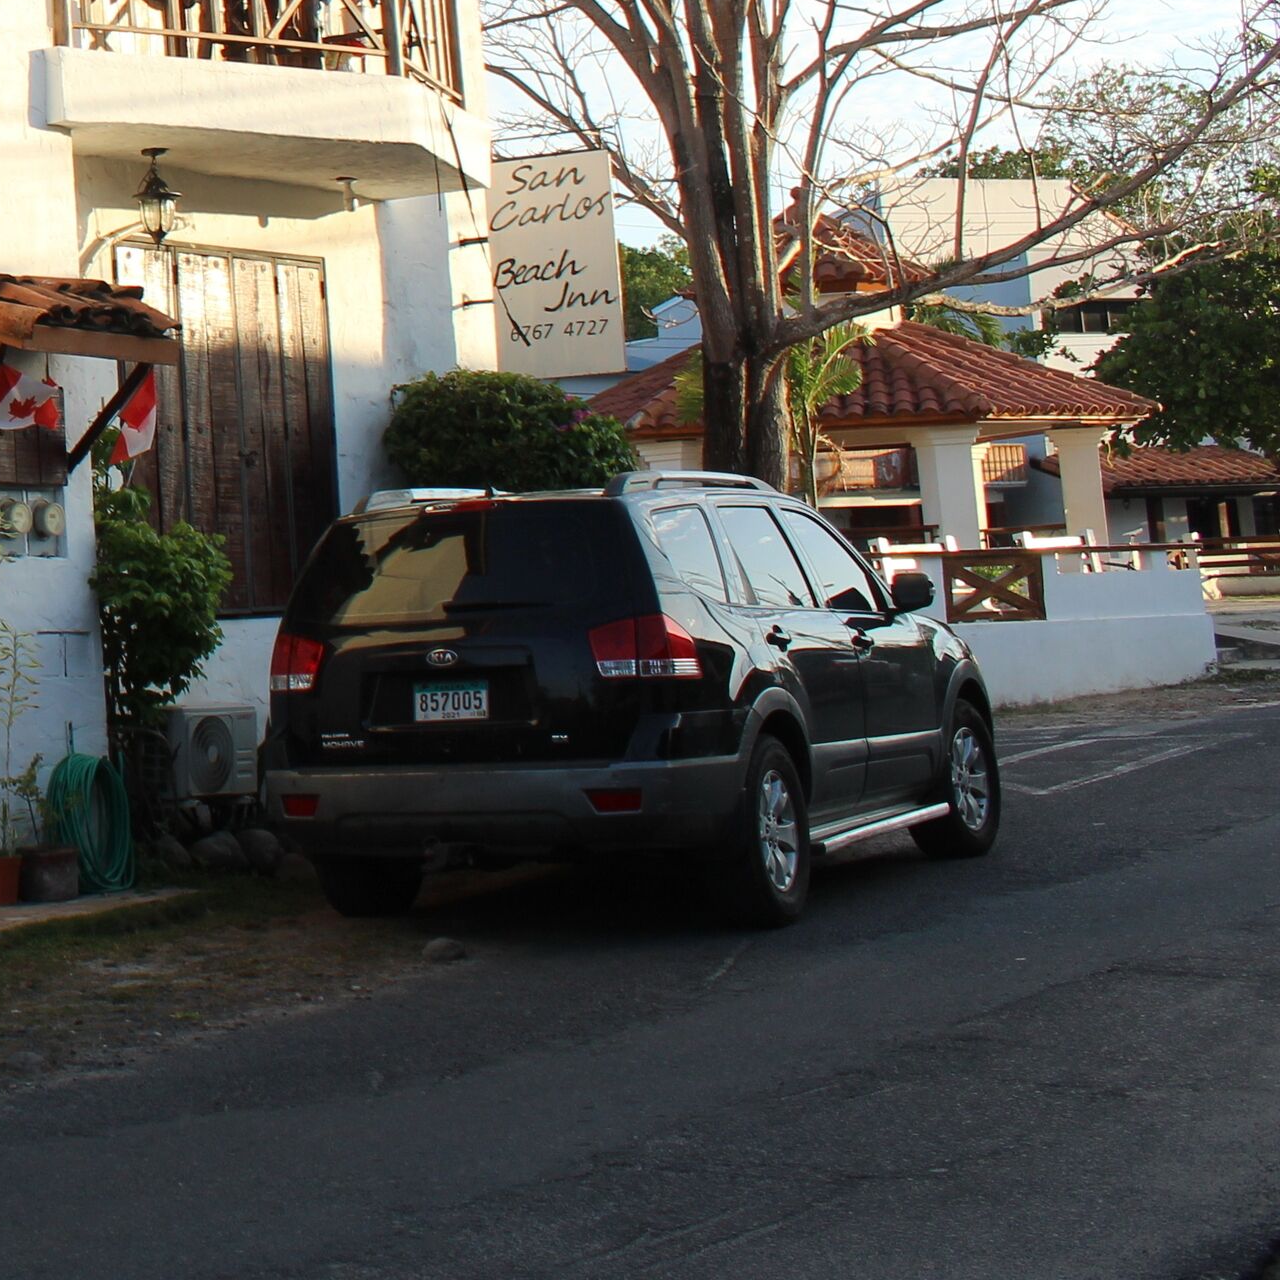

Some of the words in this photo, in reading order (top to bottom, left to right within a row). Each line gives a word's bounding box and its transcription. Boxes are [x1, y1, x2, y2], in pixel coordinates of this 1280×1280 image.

[506, 164, 585, 195] San
[489, 192, 611, 232] Carlos
[493, 249, 587, 290] Beach
[544, 281, 618, 313] Inn
[510, 322, 554, 343] 6767
[563, 318, 608, 337] 4727
[420, 691, 483, 712] 857005
